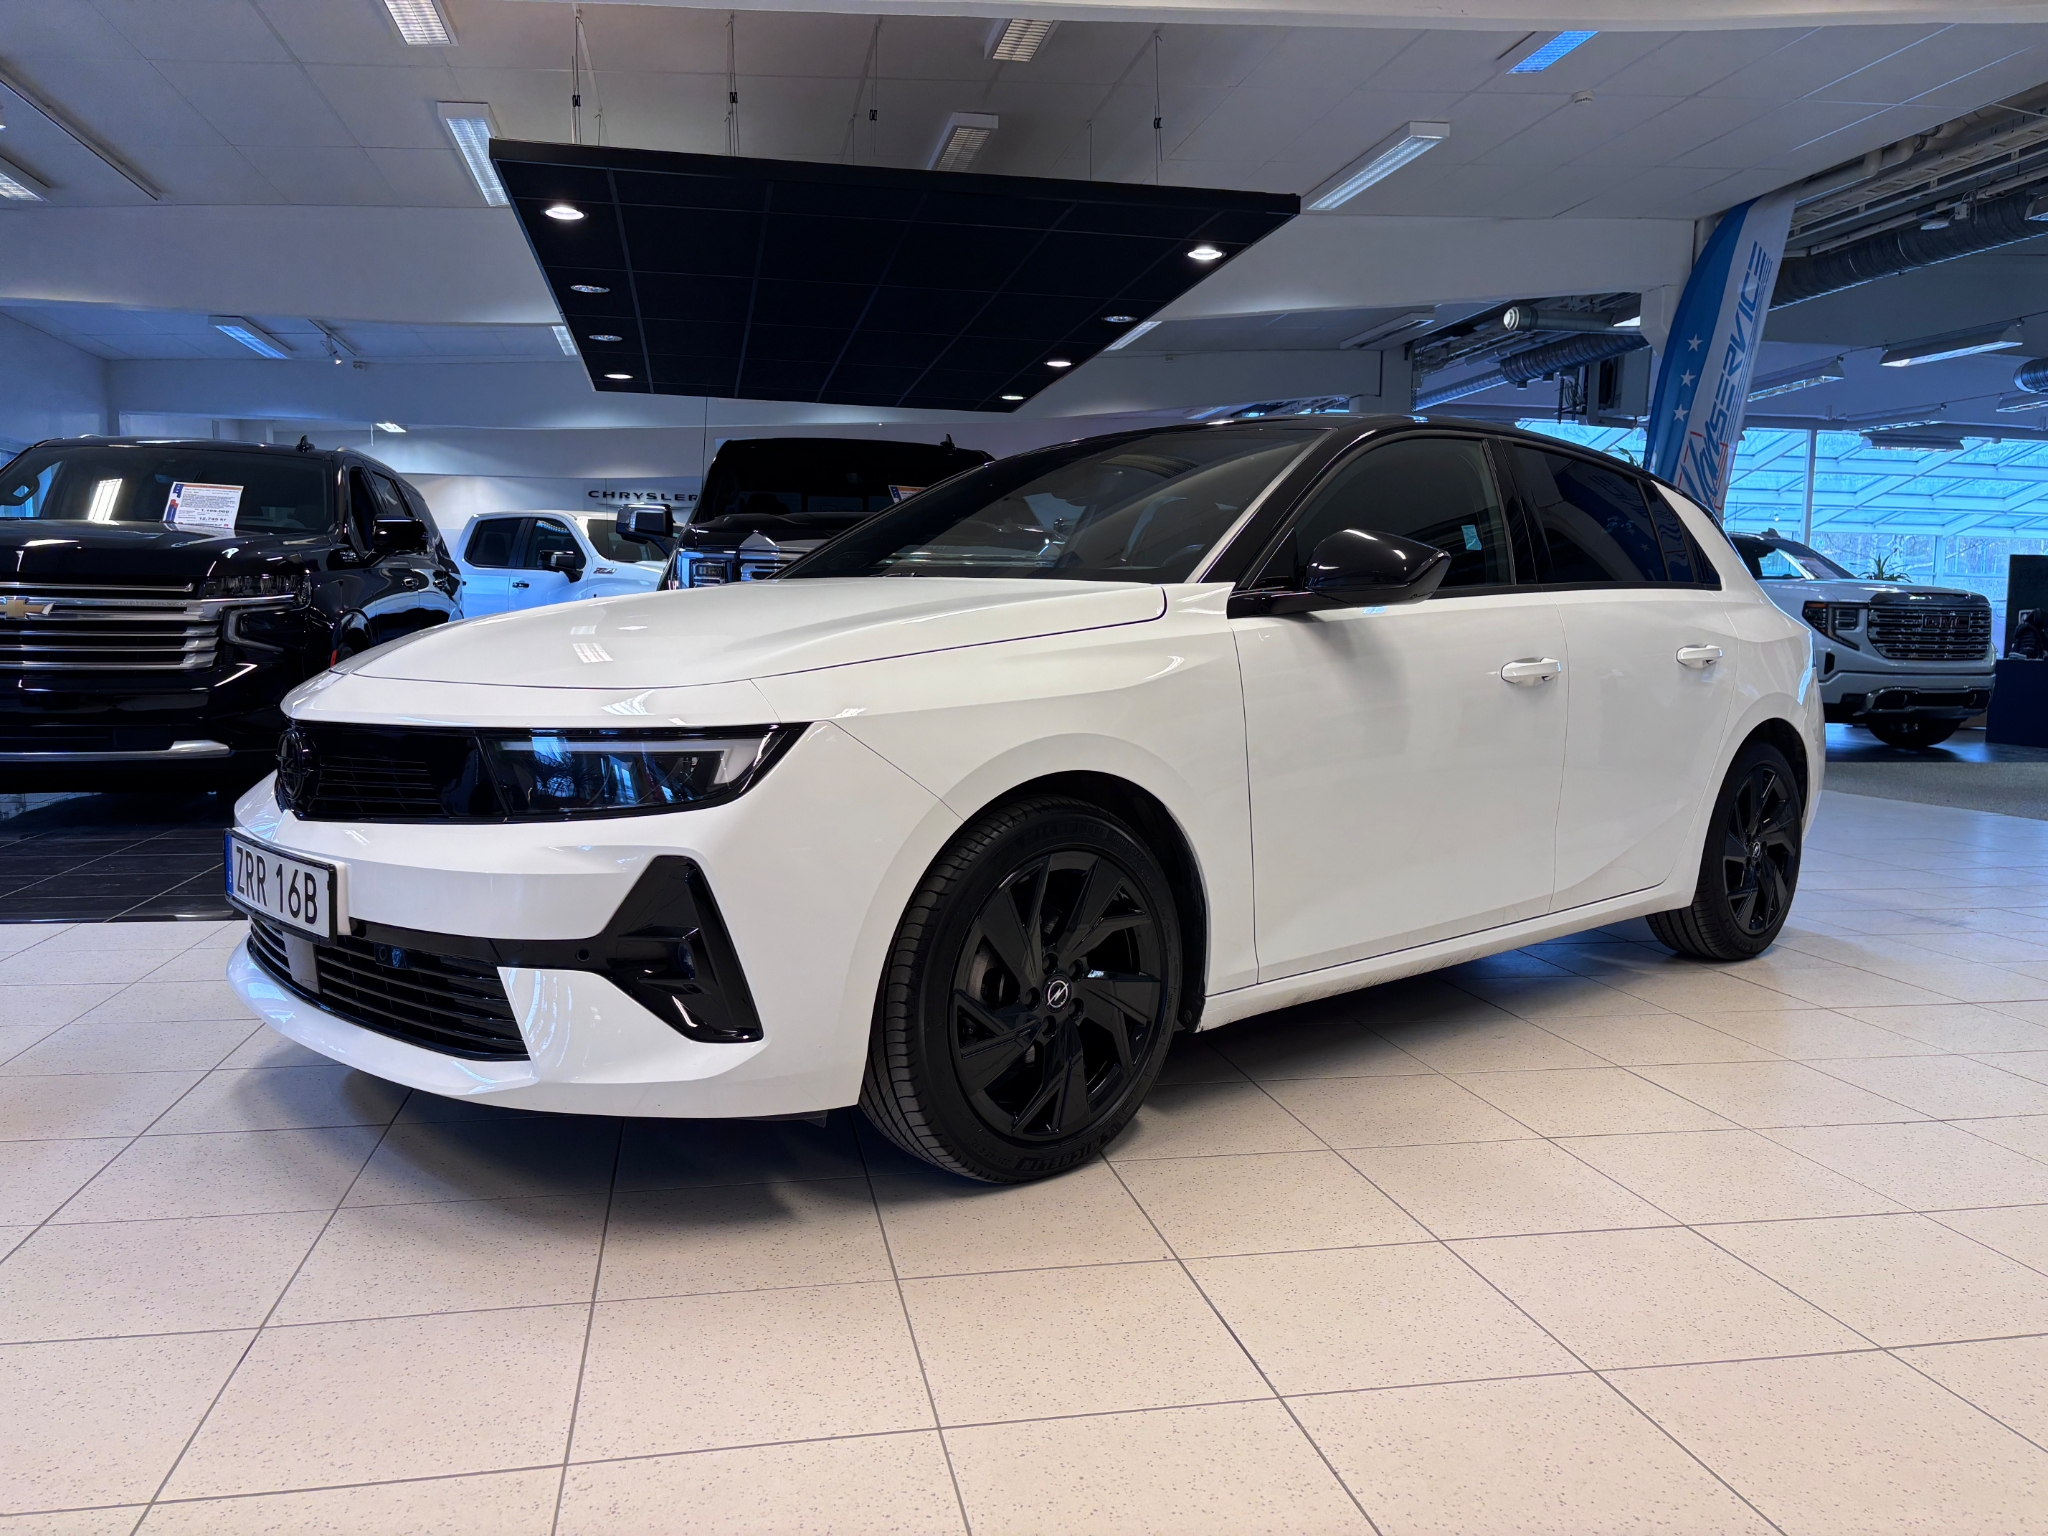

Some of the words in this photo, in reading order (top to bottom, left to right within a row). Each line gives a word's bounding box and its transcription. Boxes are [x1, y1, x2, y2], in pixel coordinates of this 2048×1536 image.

[588, 490, 699, 502] CHRYSLER
[1924, 616, 1969, 628] GMC
[236, 845, 268, 907] ZRR
[276, 863, 318, 925] 16B
[1021, 1135, 1102, 1171] MICHELIN
